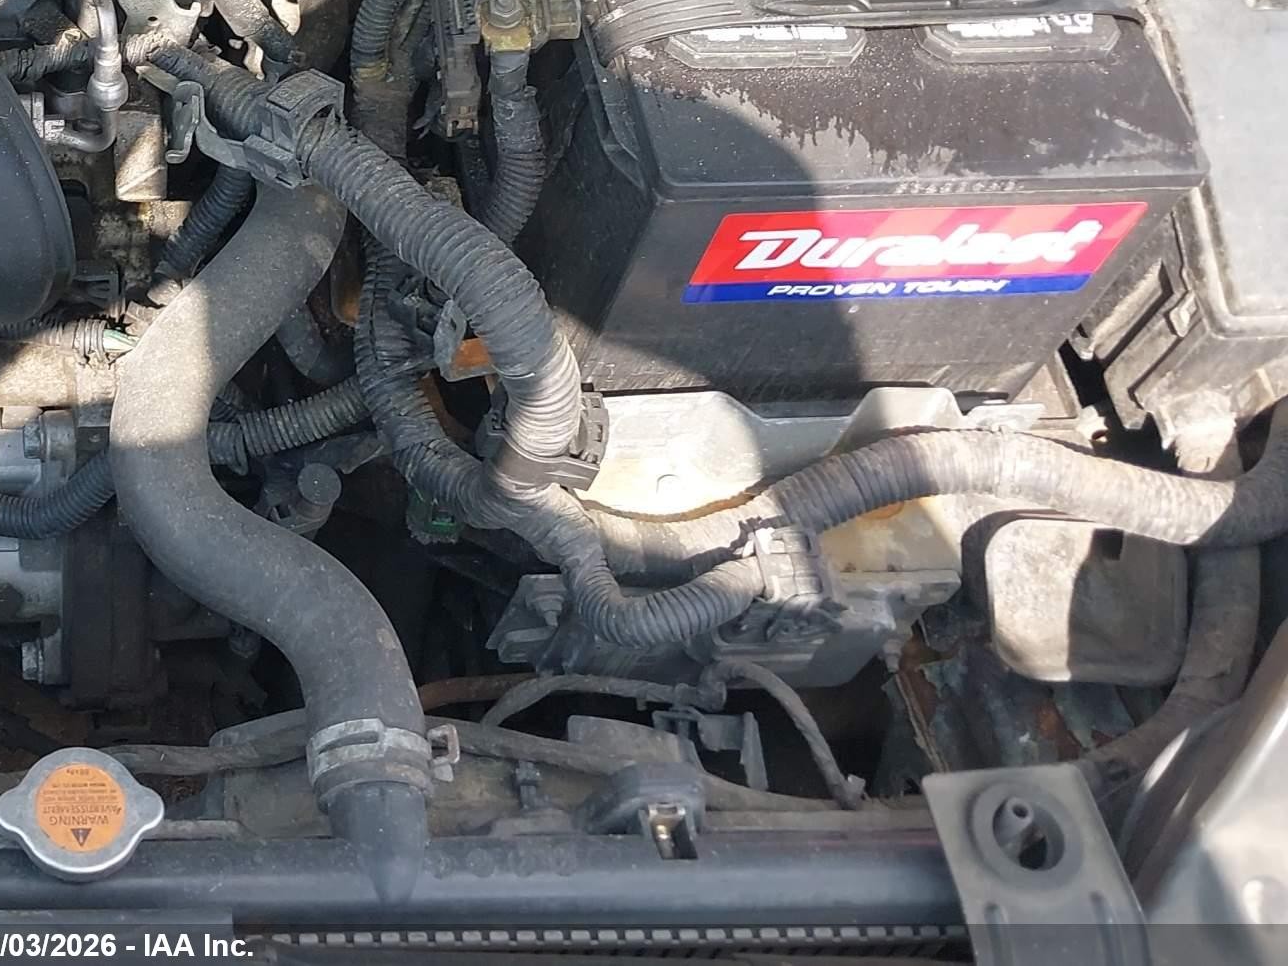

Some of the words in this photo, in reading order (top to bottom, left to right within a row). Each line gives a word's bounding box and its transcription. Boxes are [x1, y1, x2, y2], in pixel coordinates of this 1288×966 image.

[767, 280, 896, 297] PROVEN
[903, 279, 1011, 294] TOUGH
[49, 815, 109, 826] WARNING
